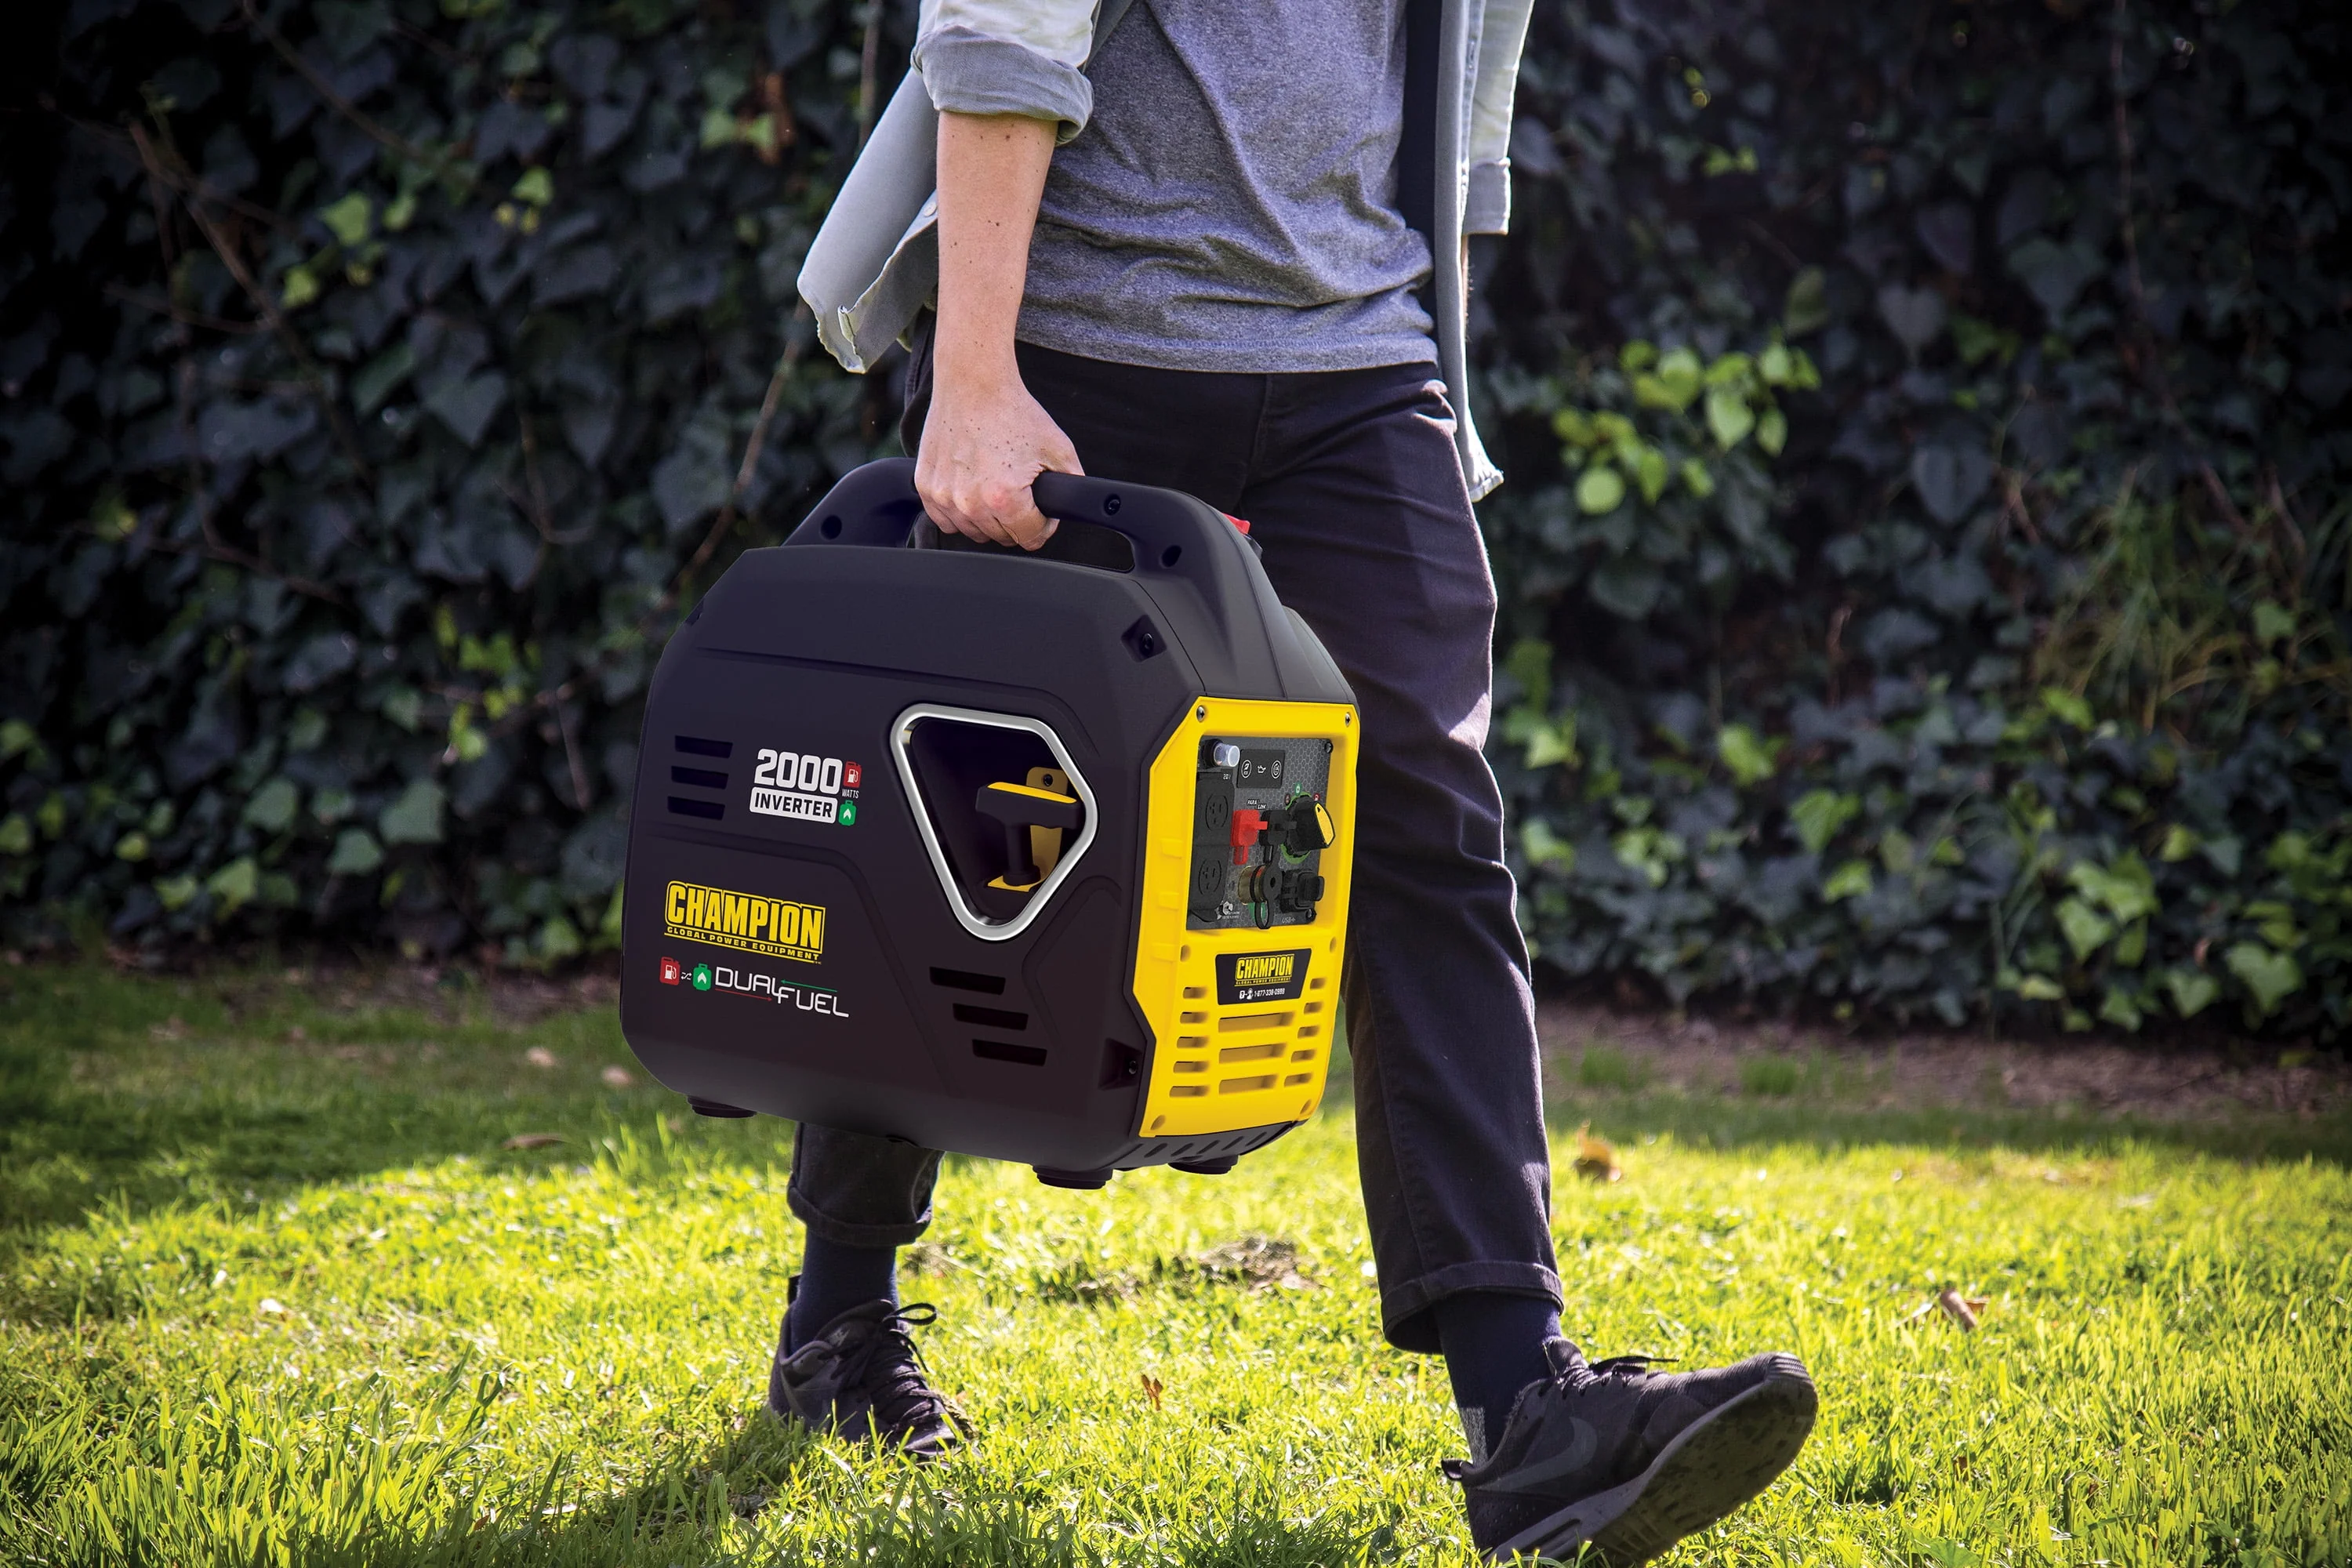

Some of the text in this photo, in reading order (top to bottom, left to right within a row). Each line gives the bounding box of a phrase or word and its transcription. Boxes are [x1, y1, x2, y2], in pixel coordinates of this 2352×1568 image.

[754, 748, 843, 795] 2000
[754, 792, 833, 818] INVERTER
[841, 788, 859, 799] WATTS
[667, 884, 823, 949] CHAMPION
[666, 926, 819, 961] GLOBAL POWER EQUIPMENT
[1236, 955, 1294, 979] CHAMPION
[714, 966, 850, 1018] DUAL FUEL
